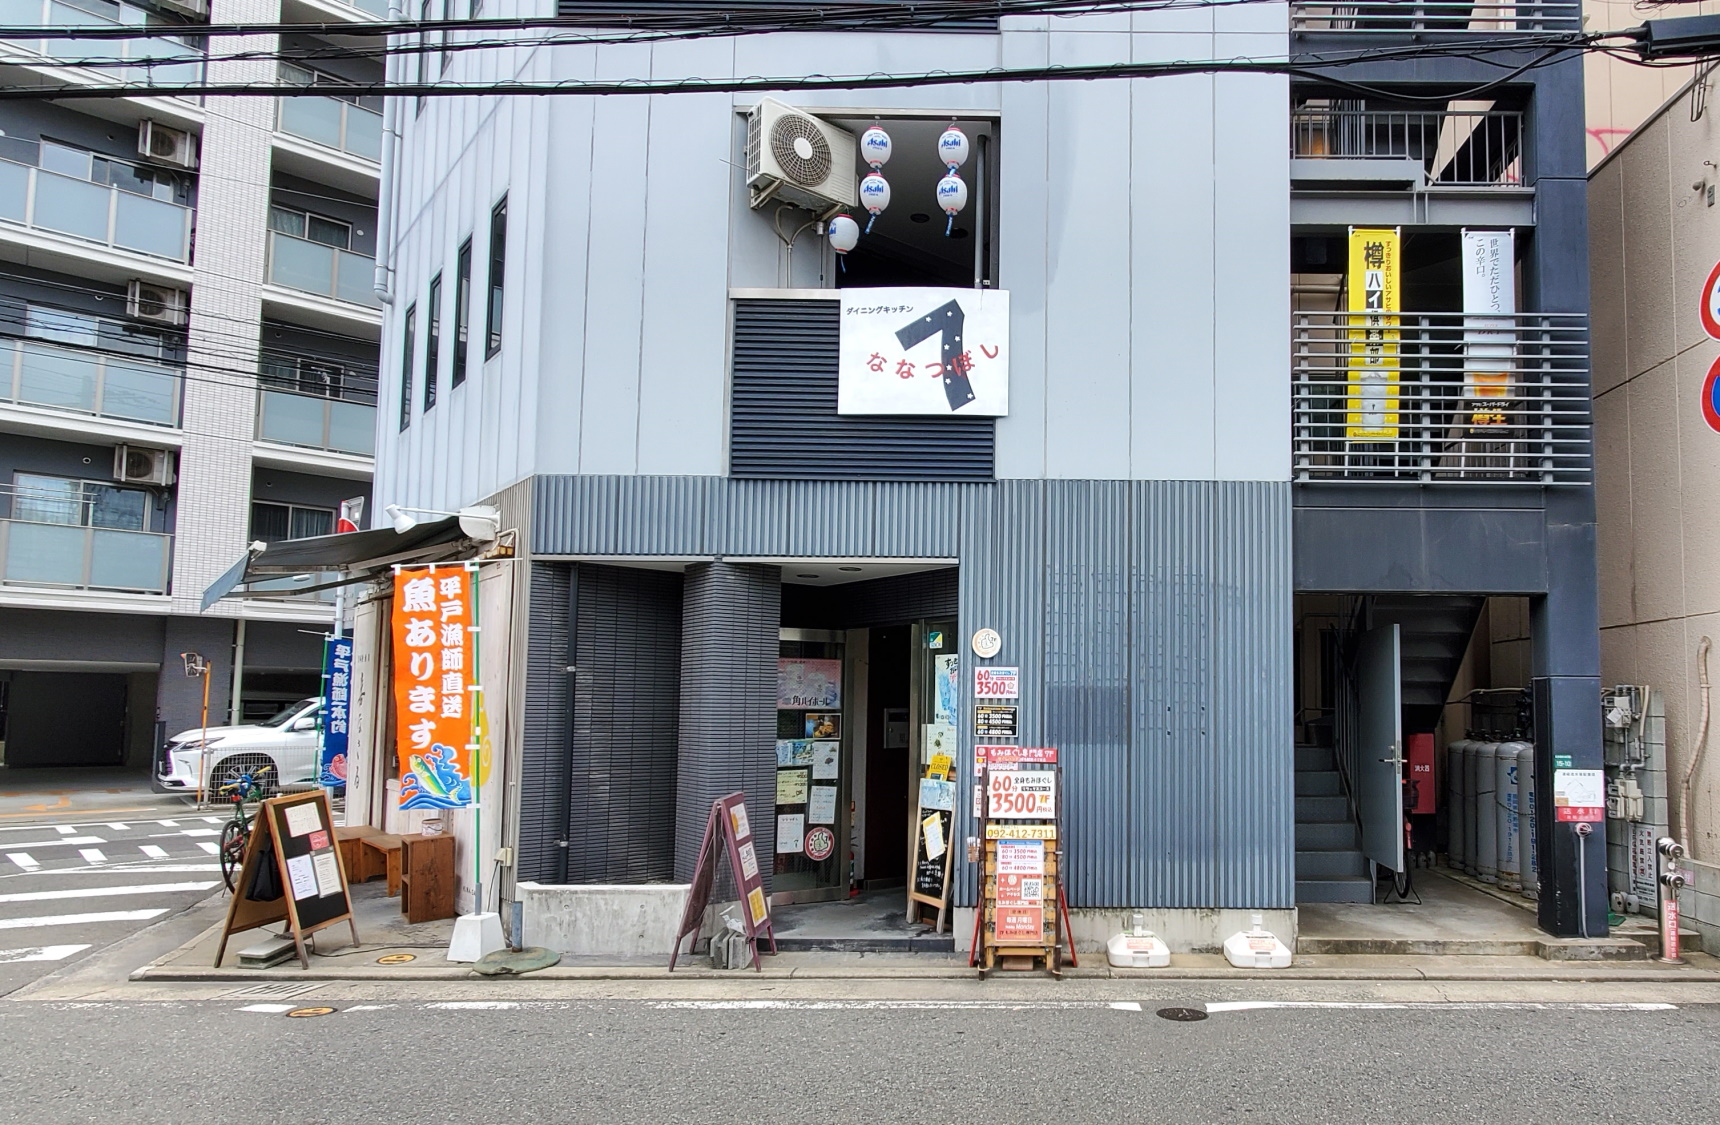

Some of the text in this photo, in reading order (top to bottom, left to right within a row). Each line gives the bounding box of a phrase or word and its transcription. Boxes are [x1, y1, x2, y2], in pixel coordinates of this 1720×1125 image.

[867, 138, 888, 148] Asahi
[941, 138, 961, 148] Asahi
[863, 184, 884, 194] Asahi
[939, 185, 959, 195] Asahi
[1475, 239, 1486, 278] この辛口。
[846, 304, 914, 316] ダイニングキッチン
[866, 343, 999, 380] ななつぼし
[439, 577, 463, 717] 平戸漁師直送
[403, 577, 437, 749] 魚あります
[1044, 750, 1055, 758] 7F
[1039, 795, 1050, 803] 7F
[987, 829, 1054, 839] 092-412-7311
[1668, 902, 1677, 928] 送水口
